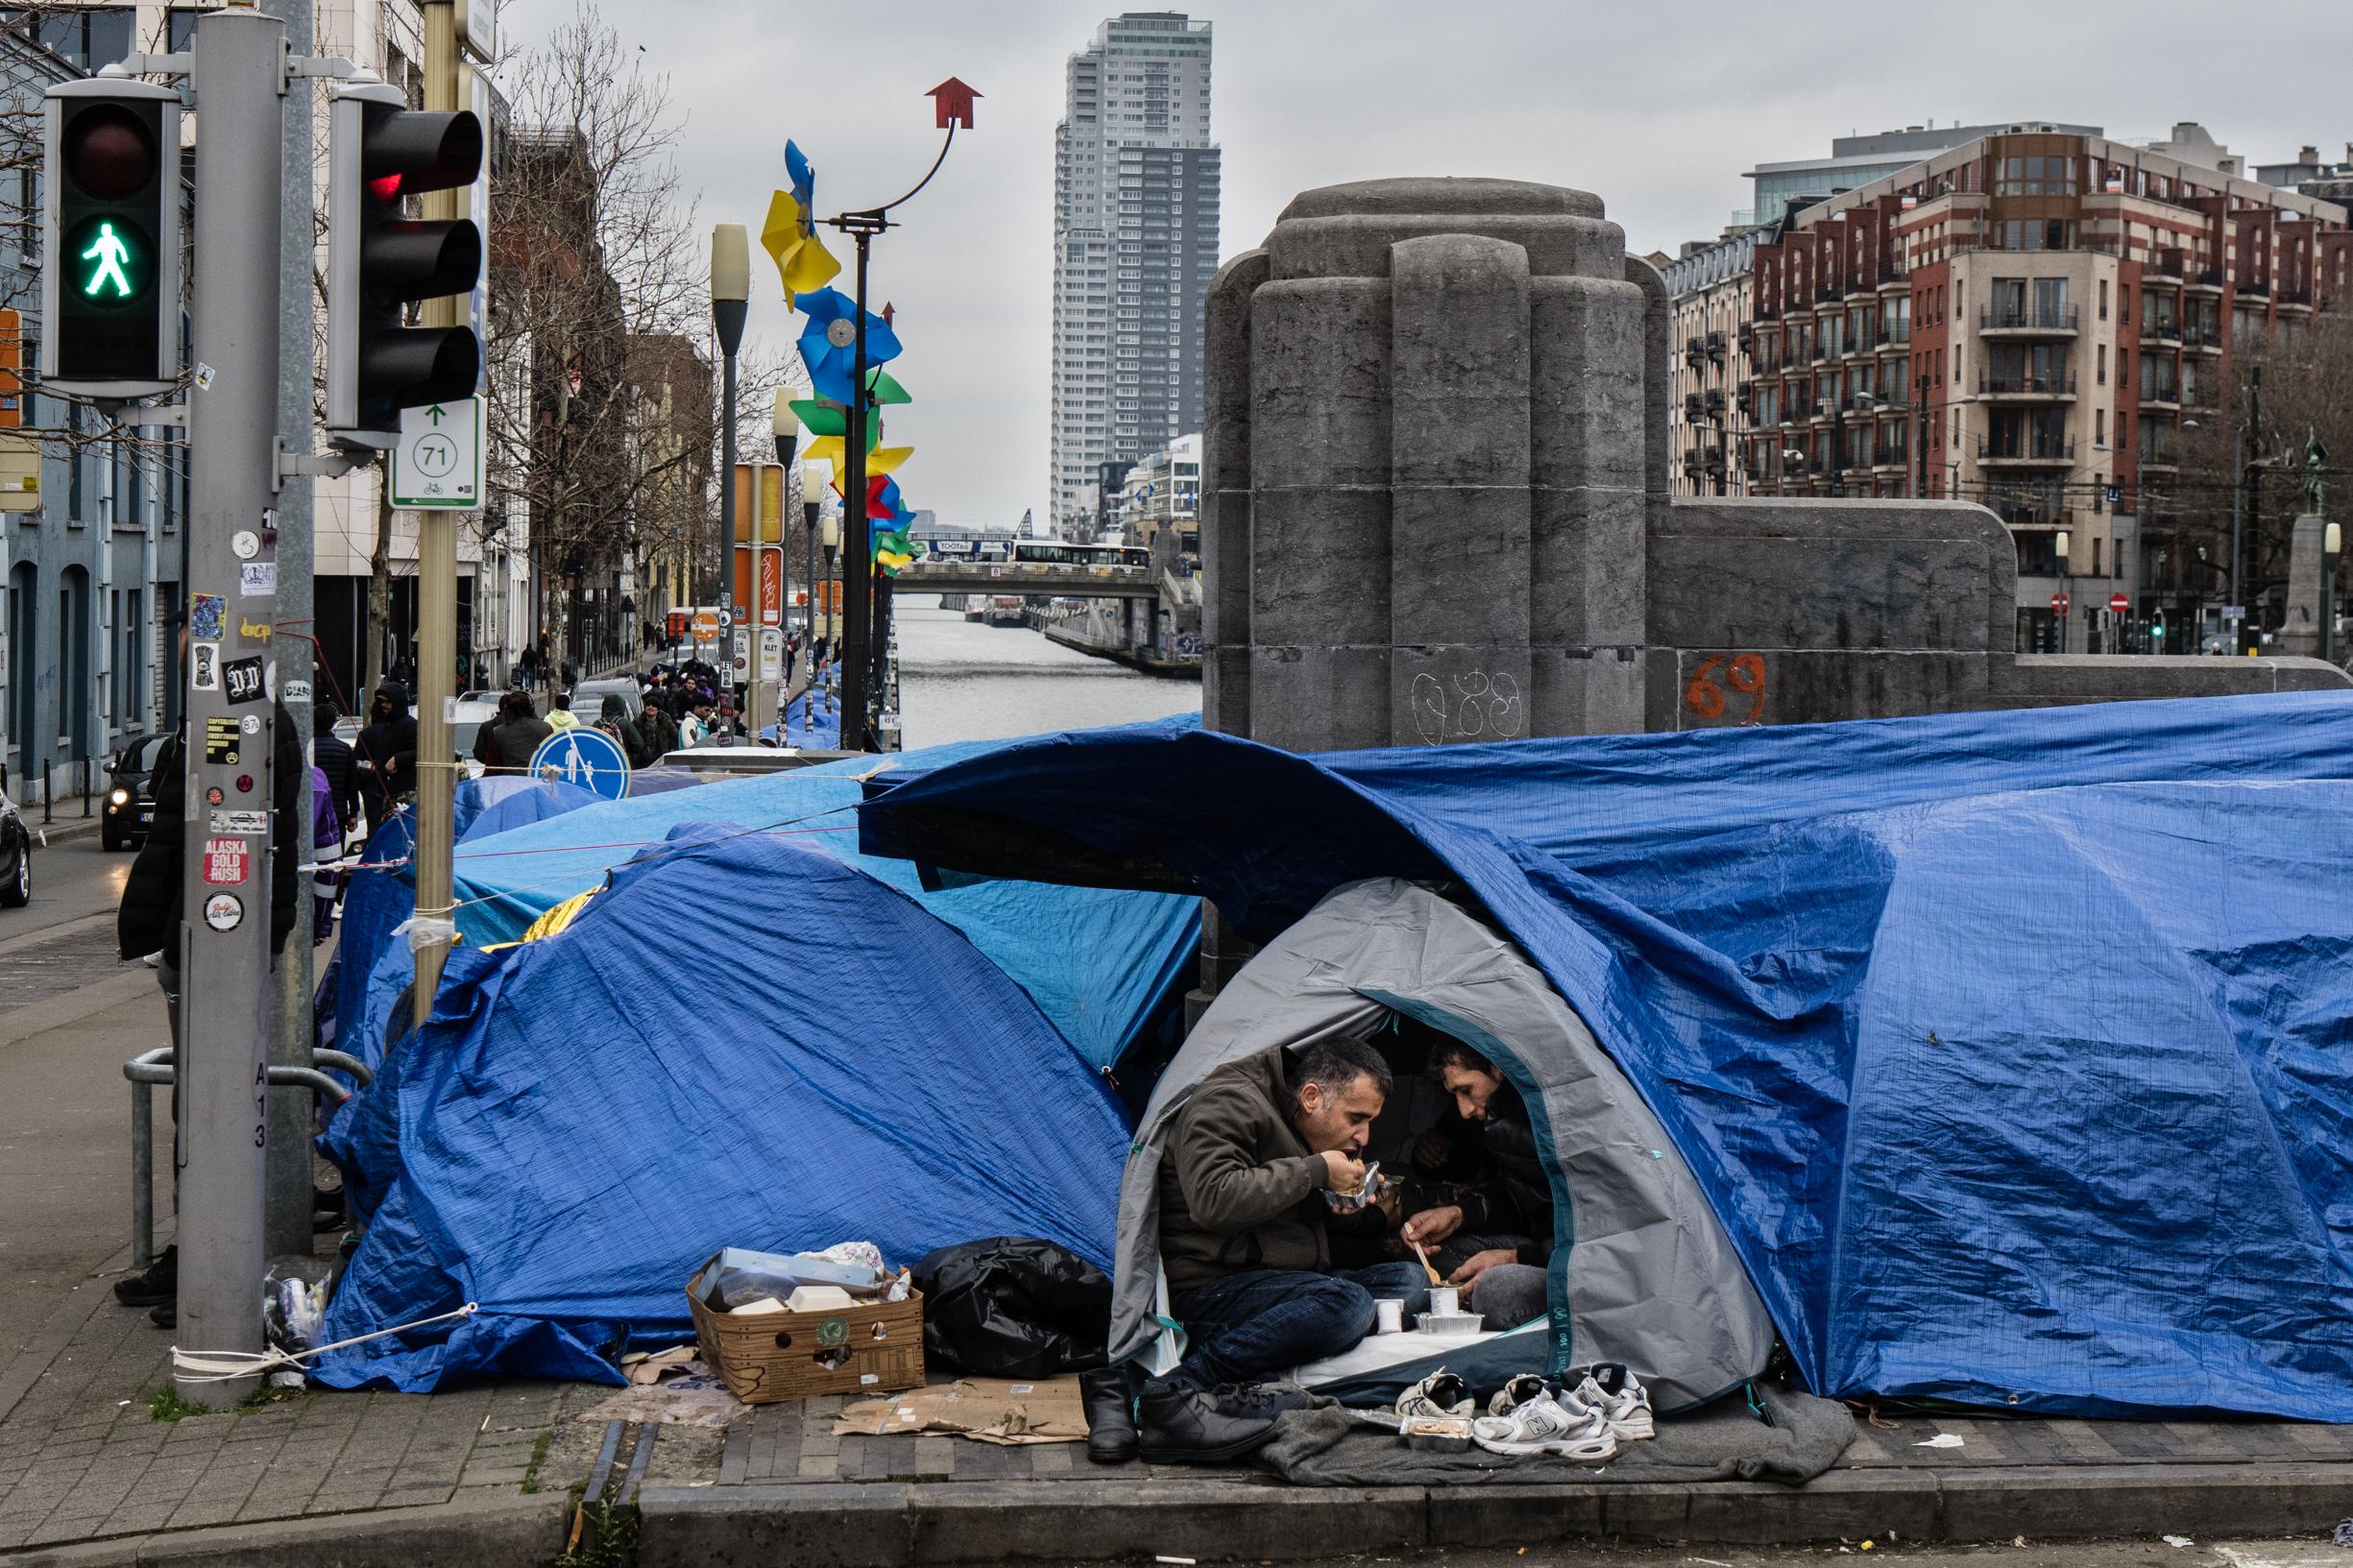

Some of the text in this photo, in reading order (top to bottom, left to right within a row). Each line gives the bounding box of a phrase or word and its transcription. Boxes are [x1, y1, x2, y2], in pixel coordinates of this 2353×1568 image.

[423, 446, 446, 466] 71
[764, 644, 778, 653] KLET
[1686, 653, 1765, 724] 69
[206, 840, 248, 855] ALASKA
[211, 854, 240, 868] GOLD
[210, 867, 241, 881] RUSH
[1559, 1333, 1567, 1347] 100
